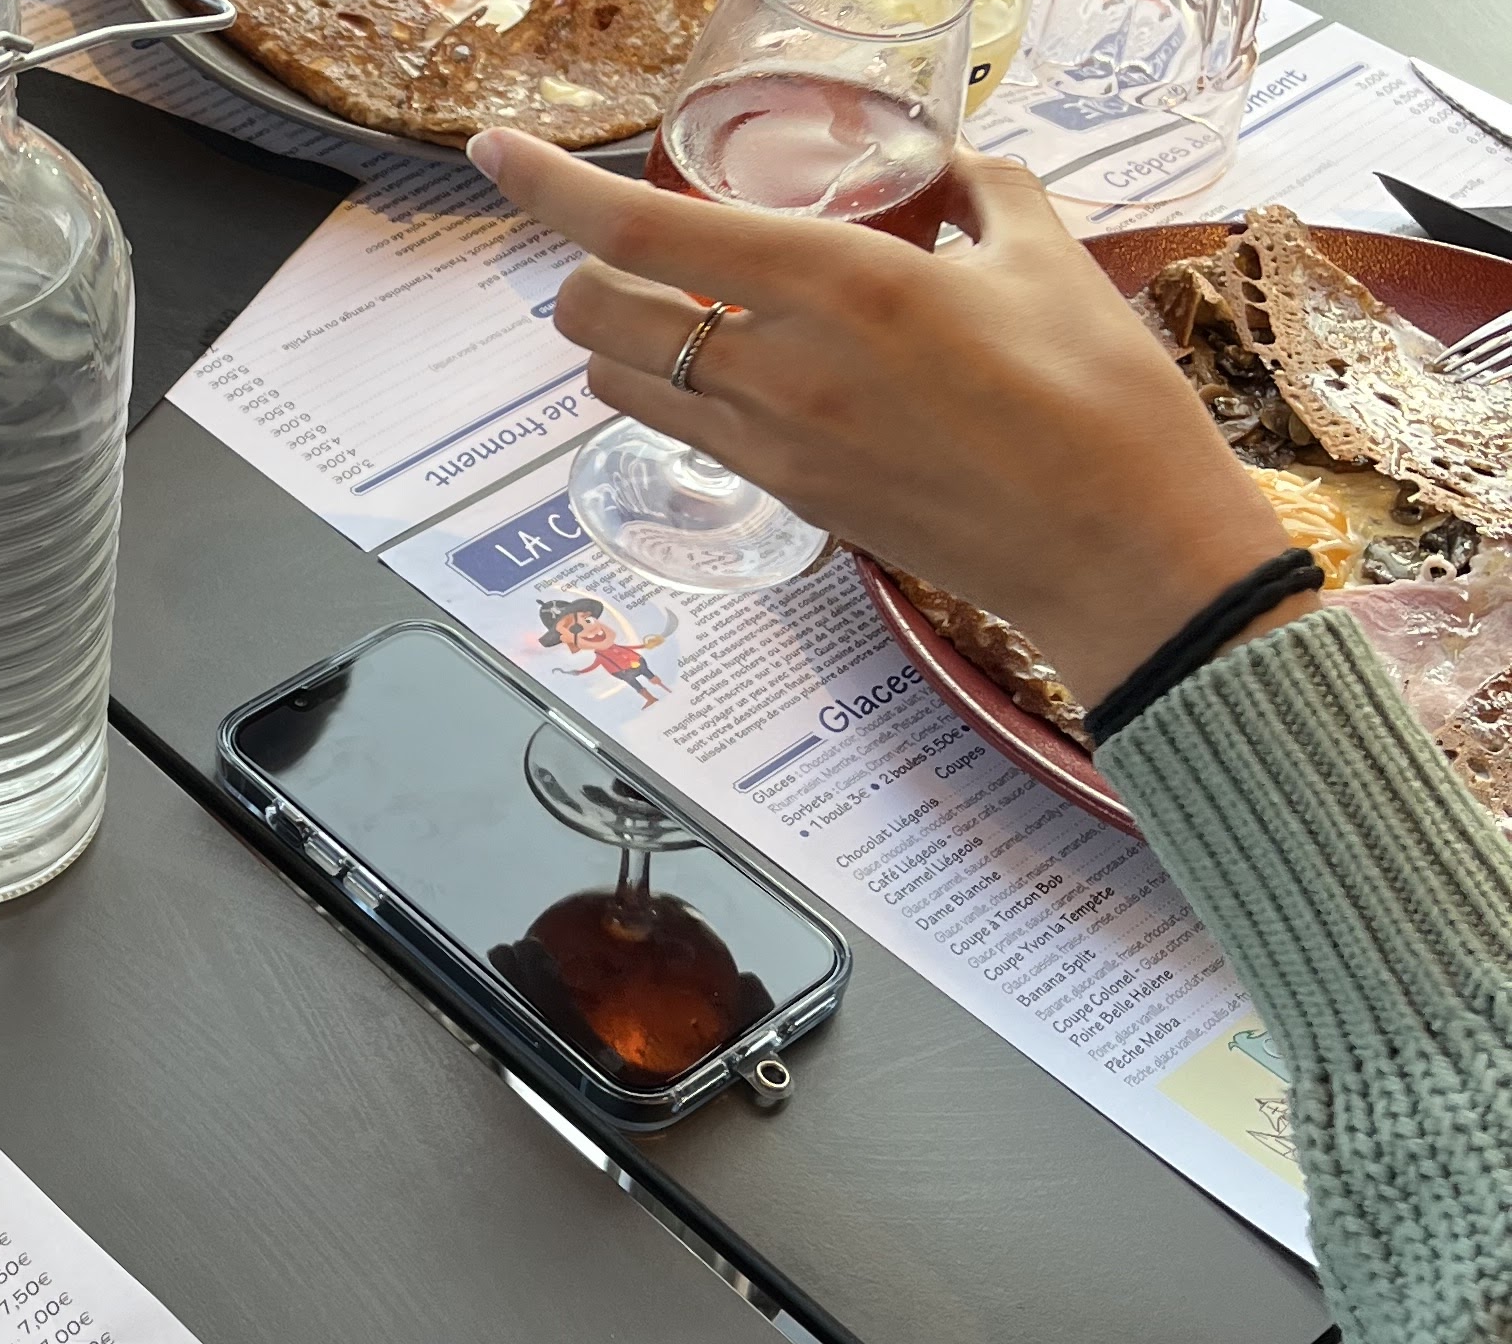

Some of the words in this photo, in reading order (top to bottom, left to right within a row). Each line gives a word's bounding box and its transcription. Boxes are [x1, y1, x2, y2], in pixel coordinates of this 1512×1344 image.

[541, 394, 579, 421] de
[424, 415, 550, 488] froment
[495, 530, 552, 567] LA
[819, 664, 924, 733] Glaces
[752, 774, 796, 805] Glaces
[822, 802, 852, 825] boule
[893, 753, 927, 778] boules
[934, 745, 986, 780] Coupes
[781, 791, 833, 826] Sorbets
[836, 829, 893, 869] Chocolat
[867, 868, 900, 894] Café
[884, 864, 938, 906] Caramel
[915, 903, 955, 931] Dame
[952, 870, 1002, 907] Blanche
[950, 924, 992, 956] Coupe
[990, 917, 999, 930] à
[997, 891, 1039, 922] Tonton
[1037, 874, 1064, 896] Bob
[984, 952, 1024, 982] Coupe
[1019, 930, 1053, 954] Yvon
[1053, 920, 1066, 936] la
[1060, 886, 1116, 926] Tempête
[1016, 971, 1066, 1008] Banana
[1062, 948, 1097, 977] Split
[1052, 1002, 1094, 1034] Coupe
[1089, 970, 1137, 1008] Colonel
[1069, 1020, 1105, 1048] Poire
[1104, 997, 1136, 1024] Belle
[1130, 970, 1174, 1003] Hélène
[1104, 1044, 1146, 1074] Pêche
[1142, 1016, 1181, 1046] Melba
[17, 1292, 73, 1335] 7,00€
